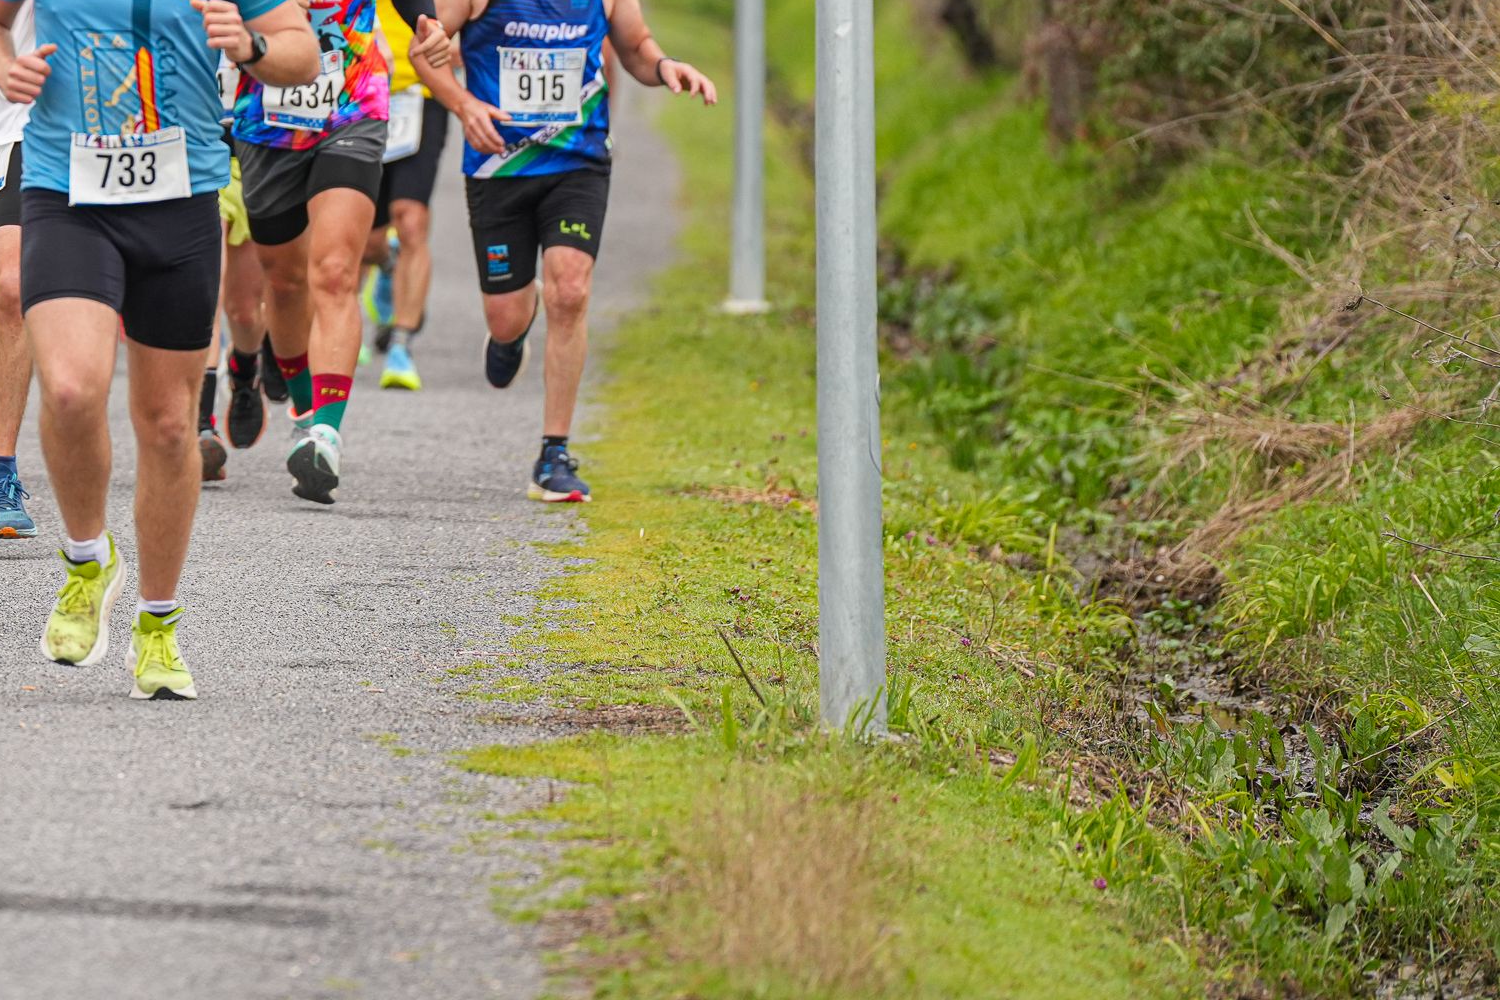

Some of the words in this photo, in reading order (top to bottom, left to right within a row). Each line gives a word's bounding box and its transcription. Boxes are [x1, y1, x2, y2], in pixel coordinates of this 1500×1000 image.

[504, 21, 588, 43] enerplus
[519, 74, 564, 101] 915
[96, 151, 156, 189] 733
